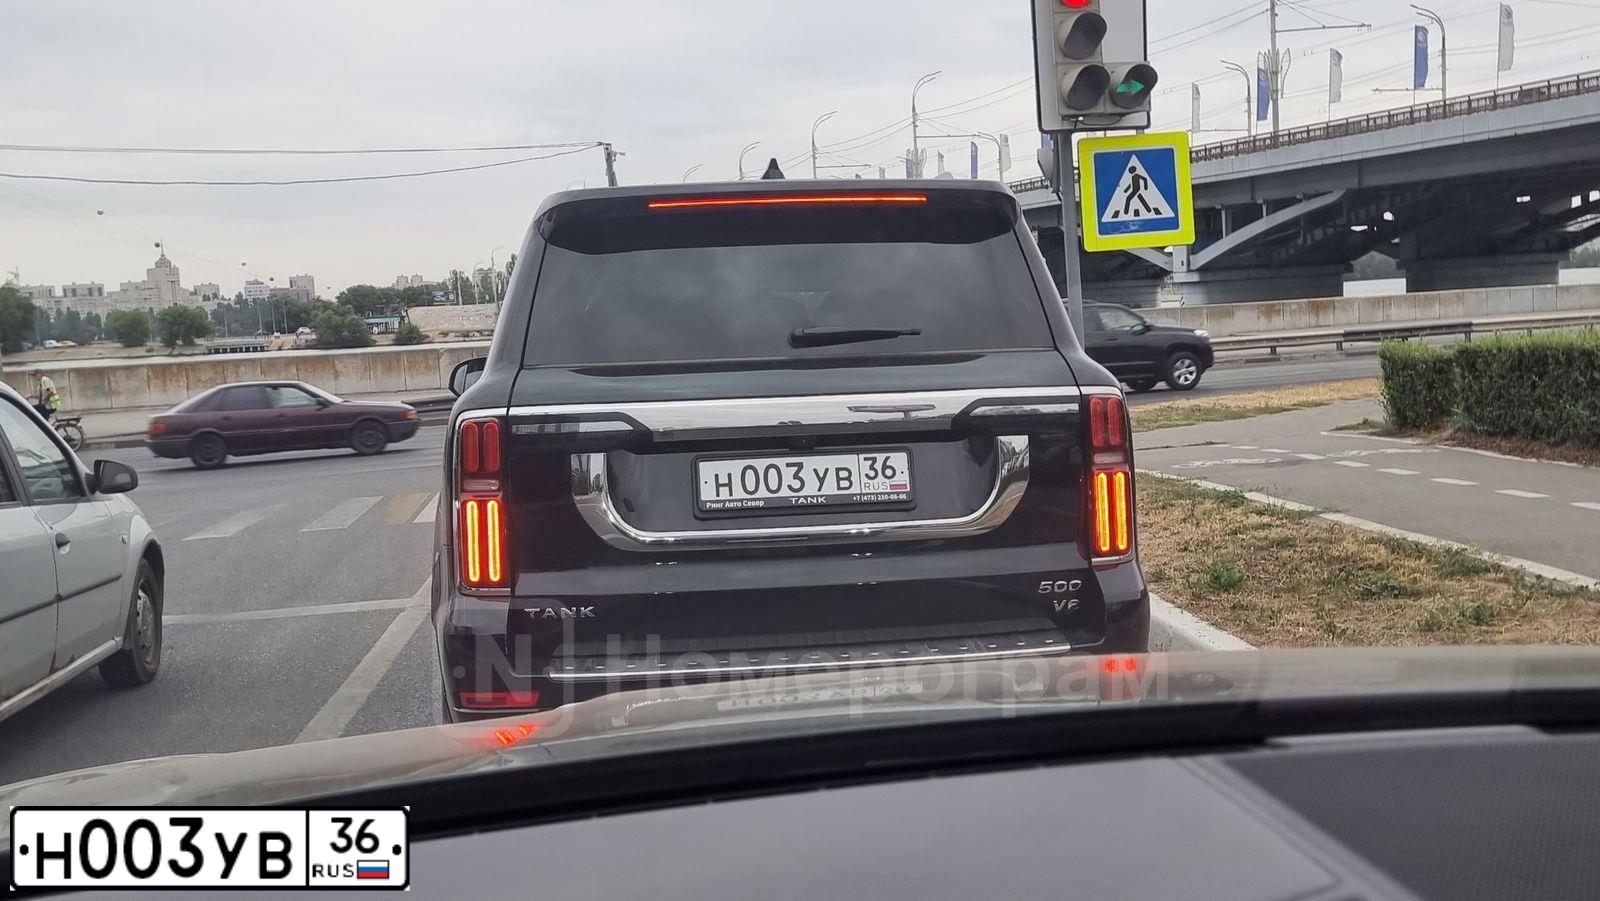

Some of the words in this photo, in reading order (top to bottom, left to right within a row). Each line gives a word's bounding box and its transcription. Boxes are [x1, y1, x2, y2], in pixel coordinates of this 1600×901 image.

[863, 456, 897, 480] 36
[864, 481, 889, 491] RUS
[706, 501, 723, 509] Ринг
[725, 500, 742, 508] Авто
[743, 499, 765, 508] Север
[789, 496, 826, 504] TANK
[1038, 579, 1082, 593] 500
[523, 605, 596, 620] TANK
